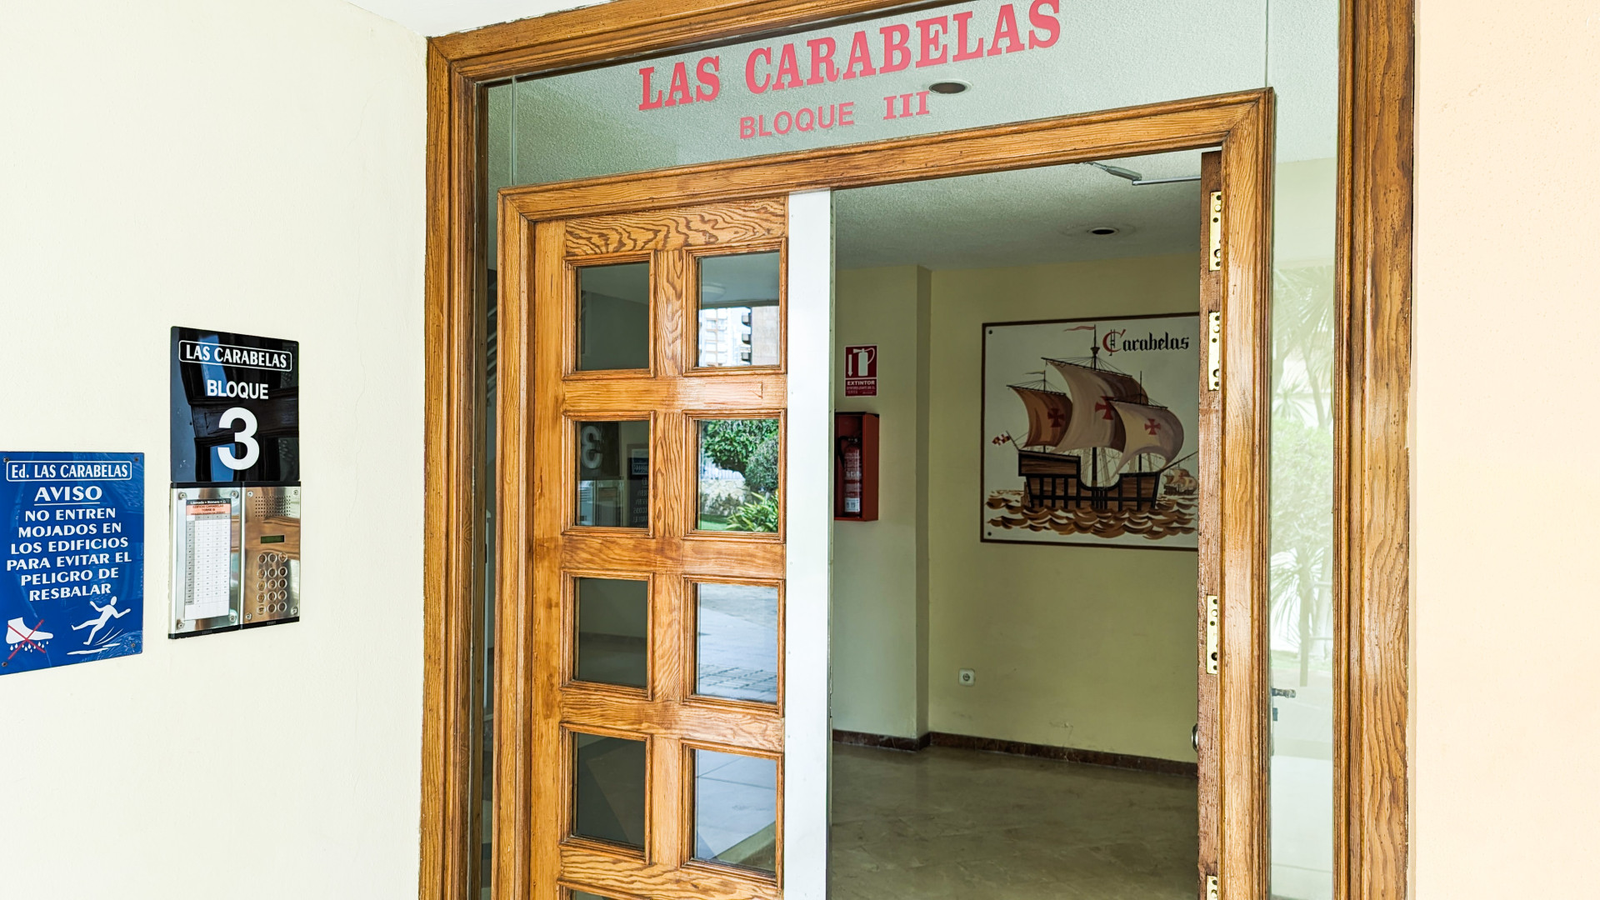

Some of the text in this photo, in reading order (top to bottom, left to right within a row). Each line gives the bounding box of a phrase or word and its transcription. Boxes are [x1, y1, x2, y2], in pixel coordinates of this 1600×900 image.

[638, 0, 1062, 111] LAS CARABELAS
[739, 90, 931, 139] BLOQUE III
[1102, 329, 1190, 356] Carabelas
[186, 344, 287, 369] LAS CARABELAS
[207, 379, 269, 400] BLOQUE
[217, 406, 260, 471] 3
[11, 464, 128, 478] Ed. LAS CARABELAS
[34, 485, 103, 502] AVISO
[25, 507, 116, 522] NO ENTREN
[18, 522, 122, 538] MOJADOS EN
[10, 536, 129, 555] LOS EDIFICIOS
[6, 551, 132, 571] PARA EVITAR EL
[21, 567, 119, 586] PELIGRO DE
[29, 583, 112, 602] RESBALAR
